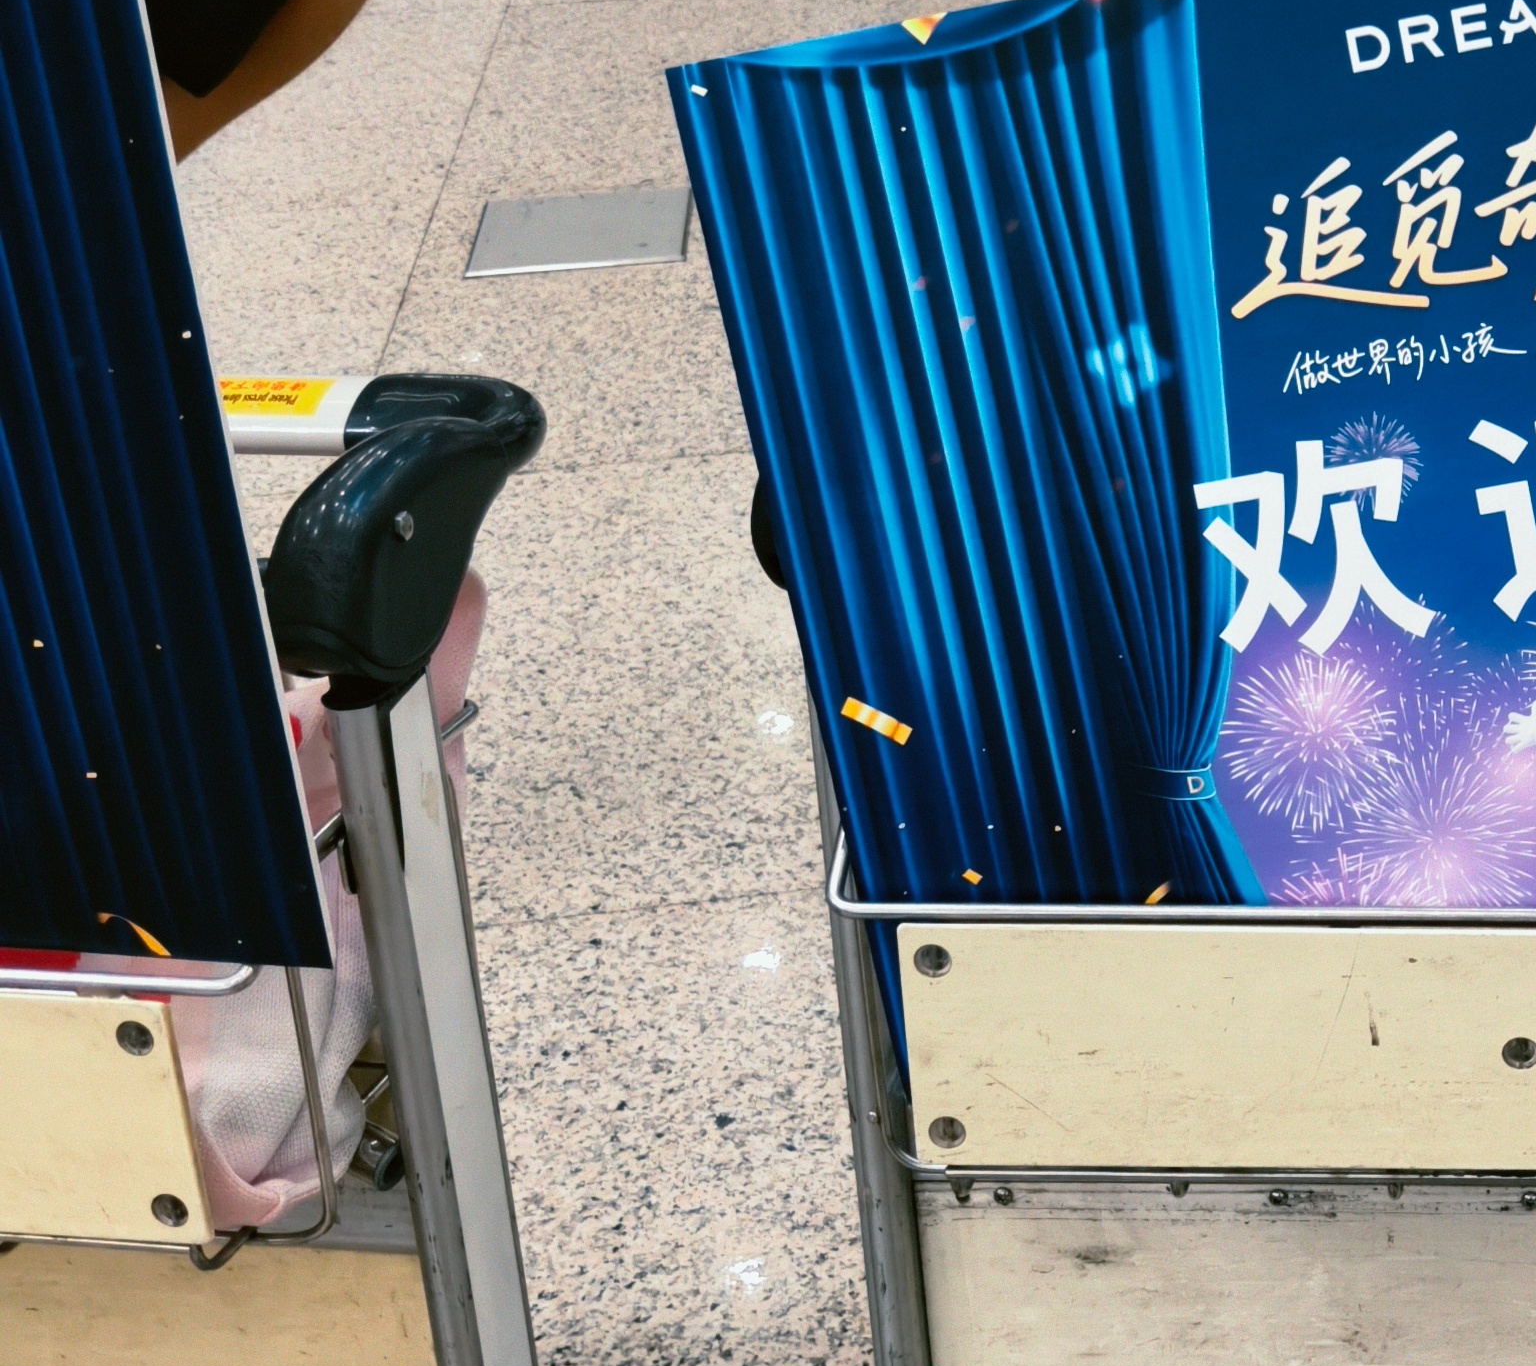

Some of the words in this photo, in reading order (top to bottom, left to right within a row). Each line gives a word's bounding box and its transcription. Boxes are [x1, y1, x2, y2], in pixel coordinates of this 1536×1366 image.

[1283, 323, 1527, 394] 做世界的小孩
[268, 393, 299, 405] Please
[1187, 776, 1205, 794] D
